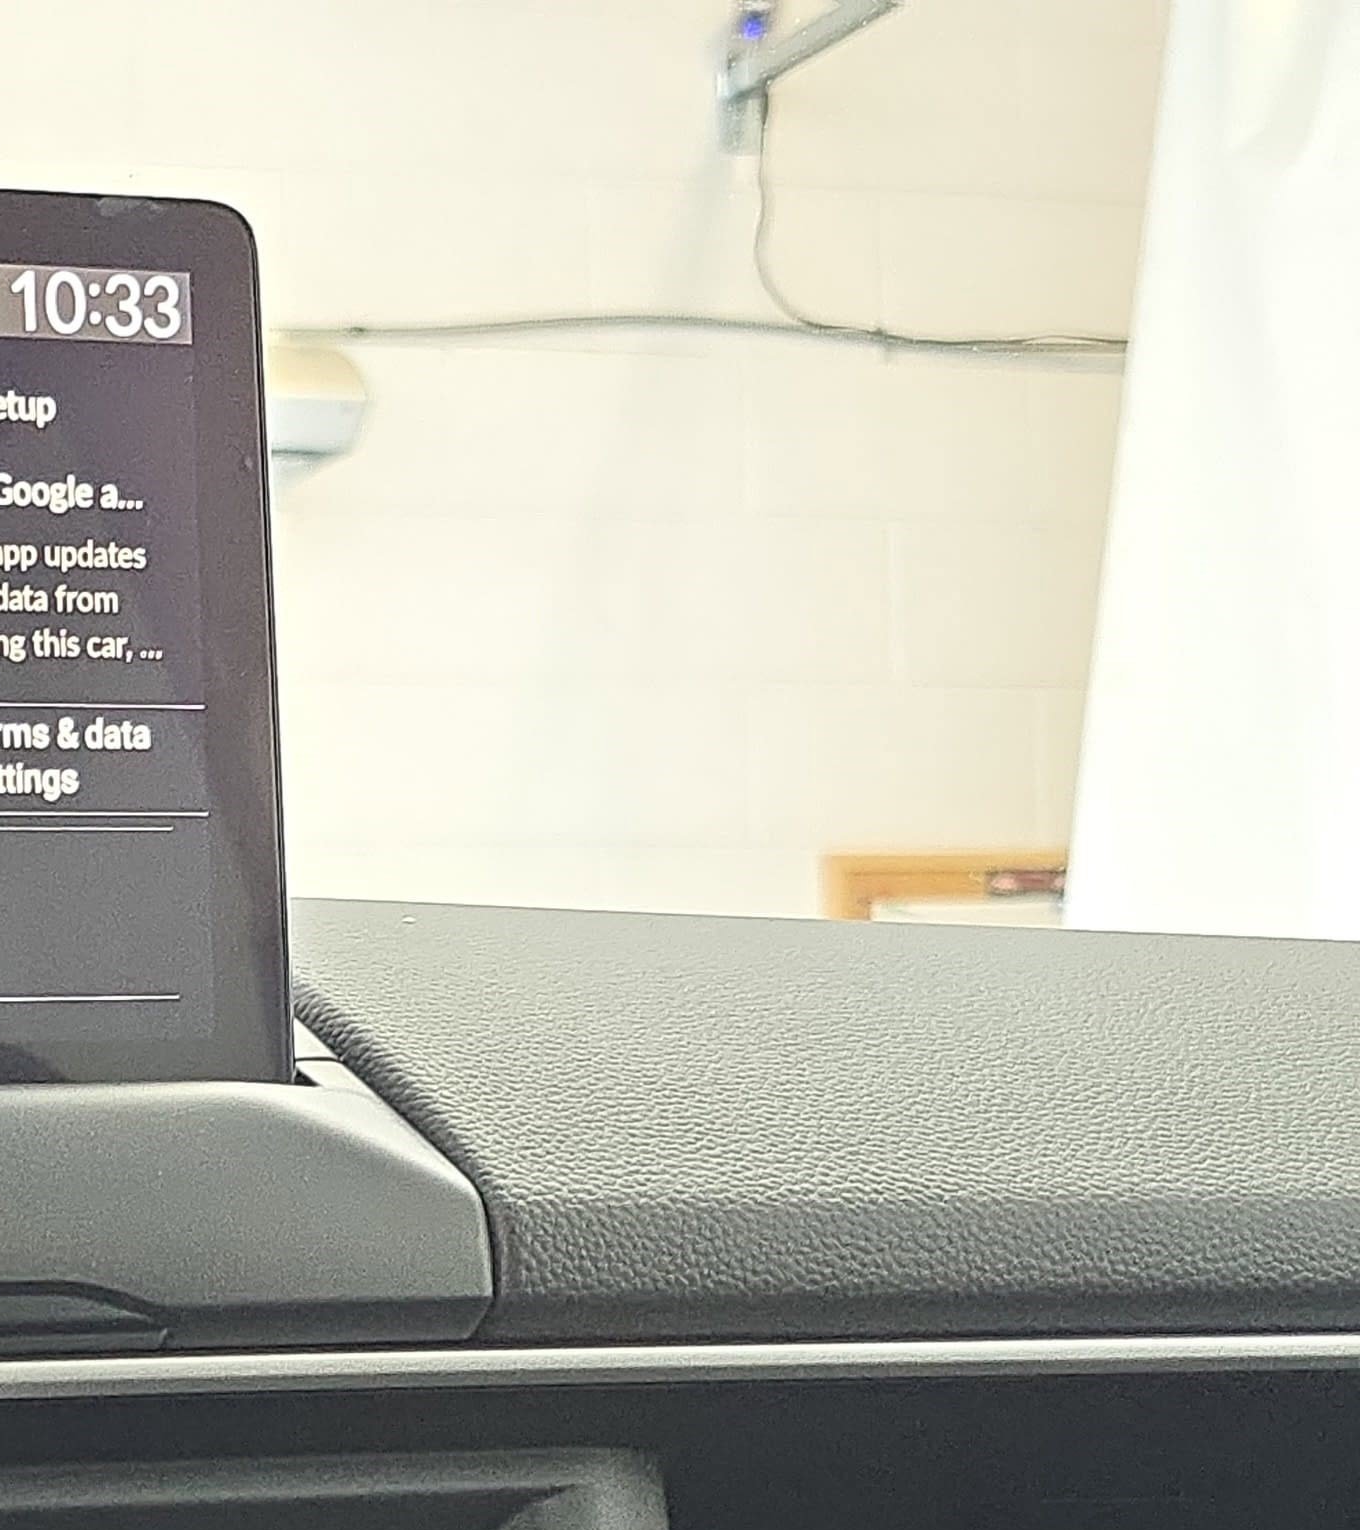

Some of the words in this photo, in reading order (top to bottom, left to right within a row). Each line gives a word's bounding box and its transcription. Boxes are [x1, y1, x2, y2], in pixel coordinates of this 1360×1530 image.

[10, 269, 182, 339] 10:33
[100, 483, 144, 510] a...
[43, 538, 147, 571] updates
[53, 583, 120, 614] from
[32, 627, 81, 662] this
[86, 635, 133, 664] car,
[56, 715, 80, 750] &
[84, 717, 153, 754] data
